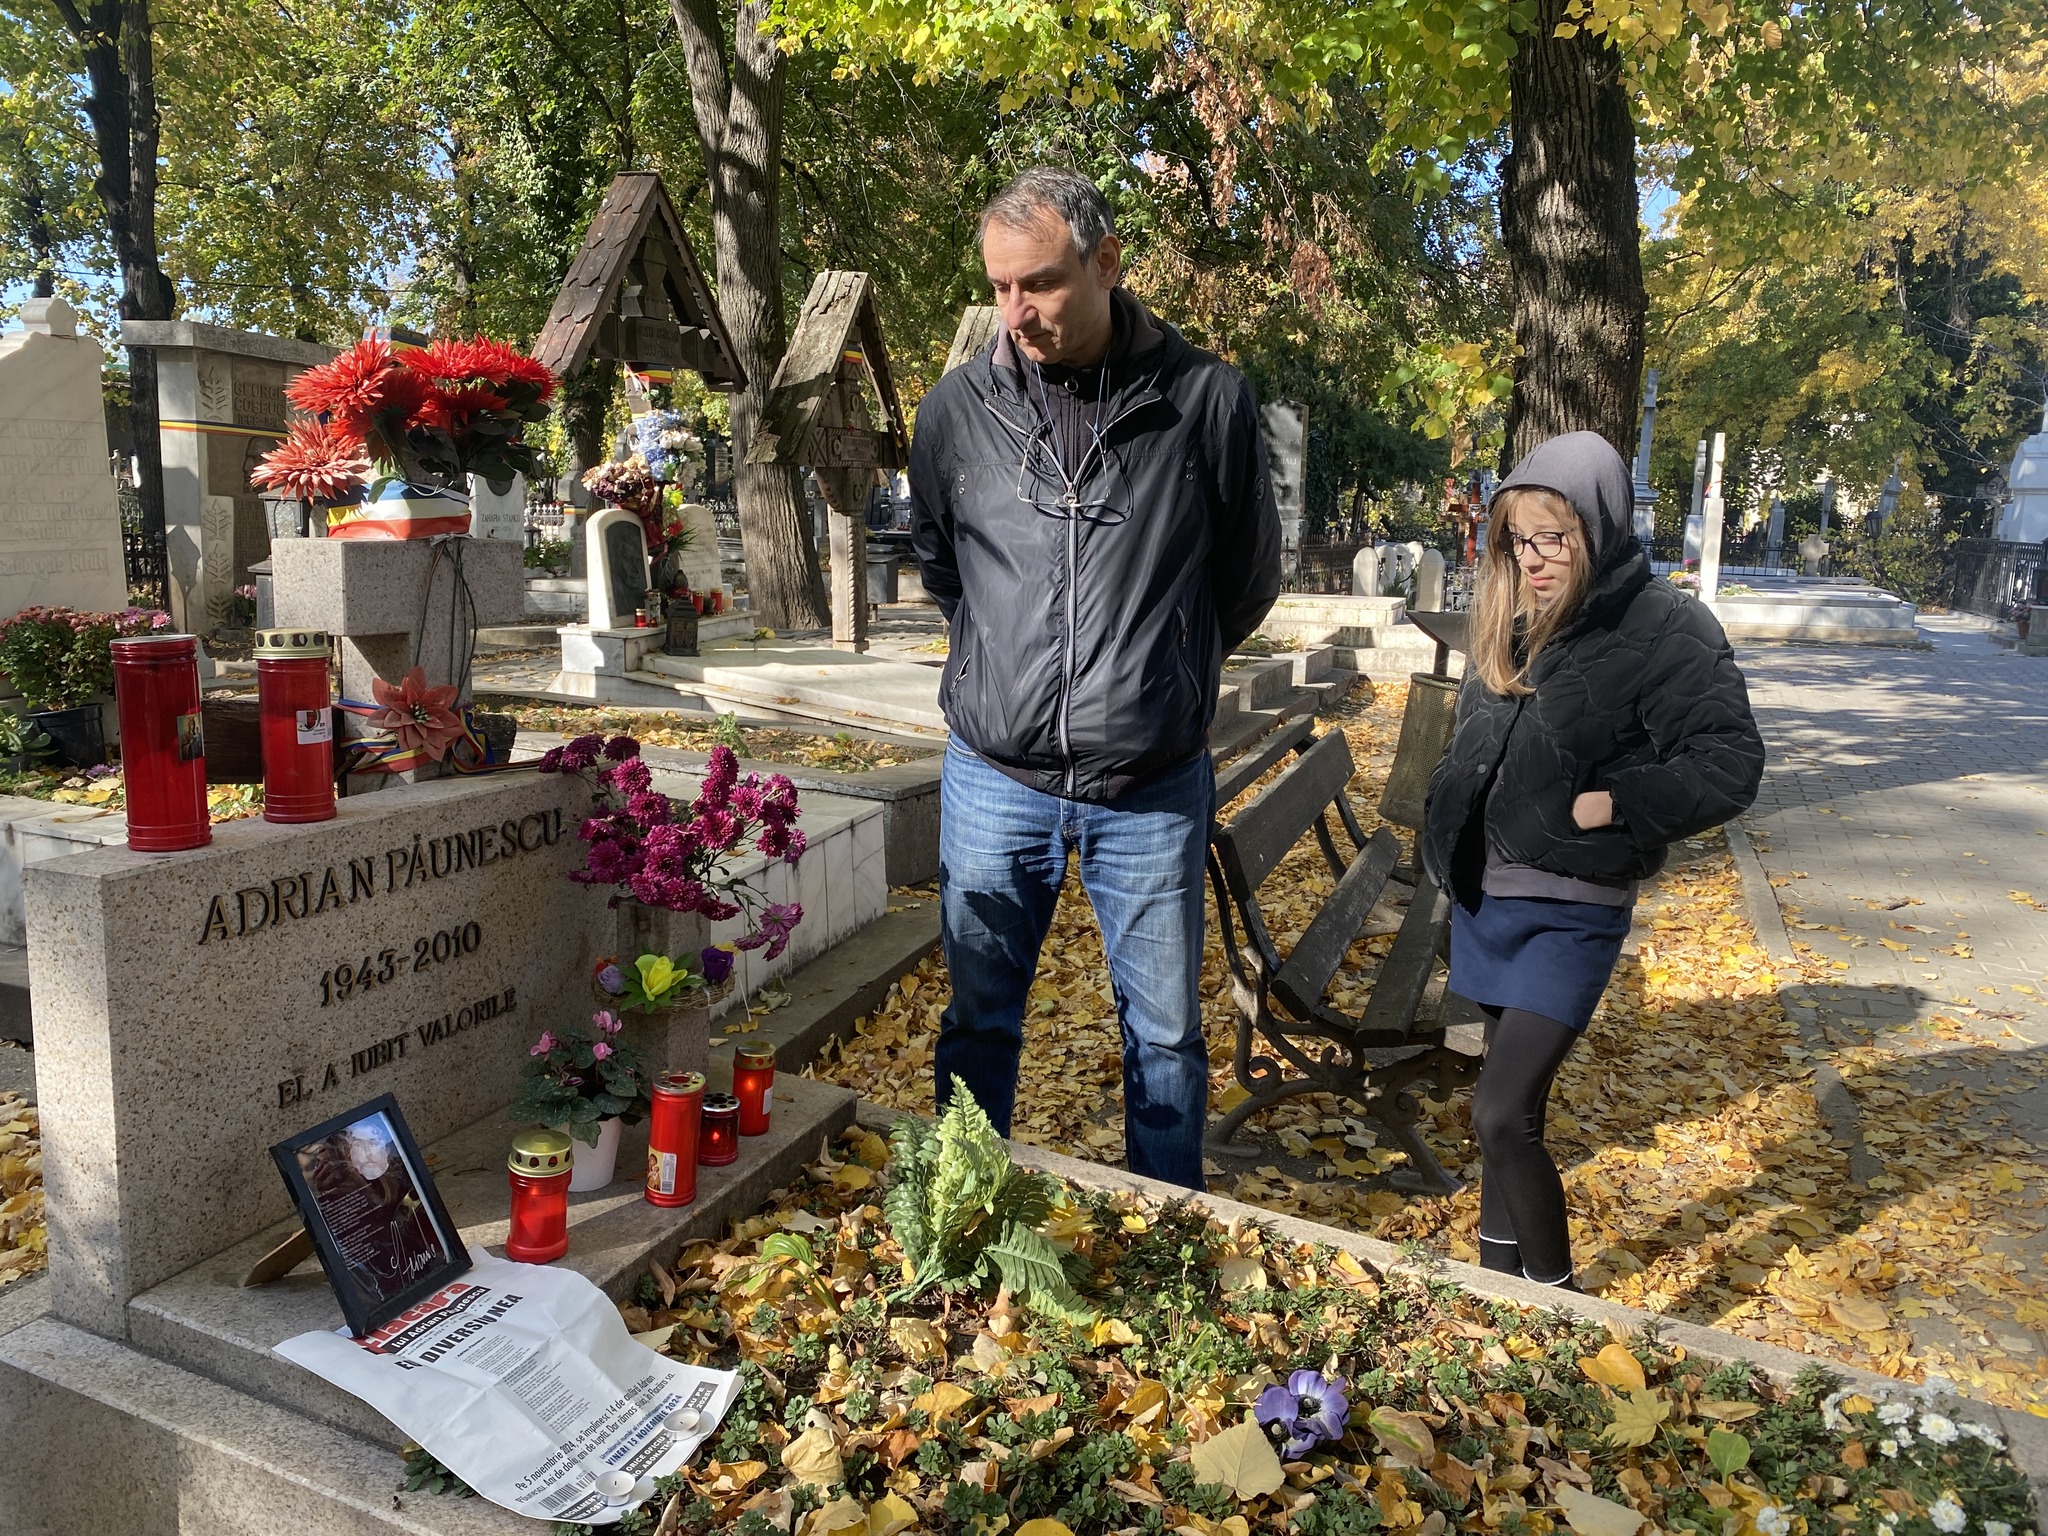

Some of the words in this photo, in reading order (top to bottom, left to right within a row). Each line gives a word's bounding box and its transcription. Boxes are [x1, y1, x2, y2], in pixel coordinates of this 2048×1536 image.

[199, 856, 377, 946] ADRIAN
[320, 921, 483, 1007] 1943-2010
[277, 1074, 314, 1109] EL
[320, 1063, 341, 1092] A
[350, 1032, 411, 1078] IUBIT
[415, 987, 519, 1047] VALORILE
[391, 1336, 410, 1348] lui
[408, 1315, 442, 1338] Adrian
[605, 1404, 618, 1416] 14
[614, 1399, 625, 1409] de
[575, 1434, 585, 1444] se
[579, 1412, 611, 1438] împlinesc
[605, 1444, 630, 1466] VINERI
[627, 1437, 638, 1447] 15
[665, 1395, 682, 1411] 2024
[530, 1451, 564, 1482] noiembrie
[543, 1474, 557, 1487] Ani
[554, 1469, 565, 1479] de
[577, 1448, 589, 1460] ani
[585, 1442, 596, 1452] de
[606, 1421, 620, 1433] Dar
[625, 1454, 647, 1472] ORICE
[644, 1436, 666, 1455] OFICIU
[515, 1482, 528, 1491] Pe
[523, 1475, 533, 1486] 5
